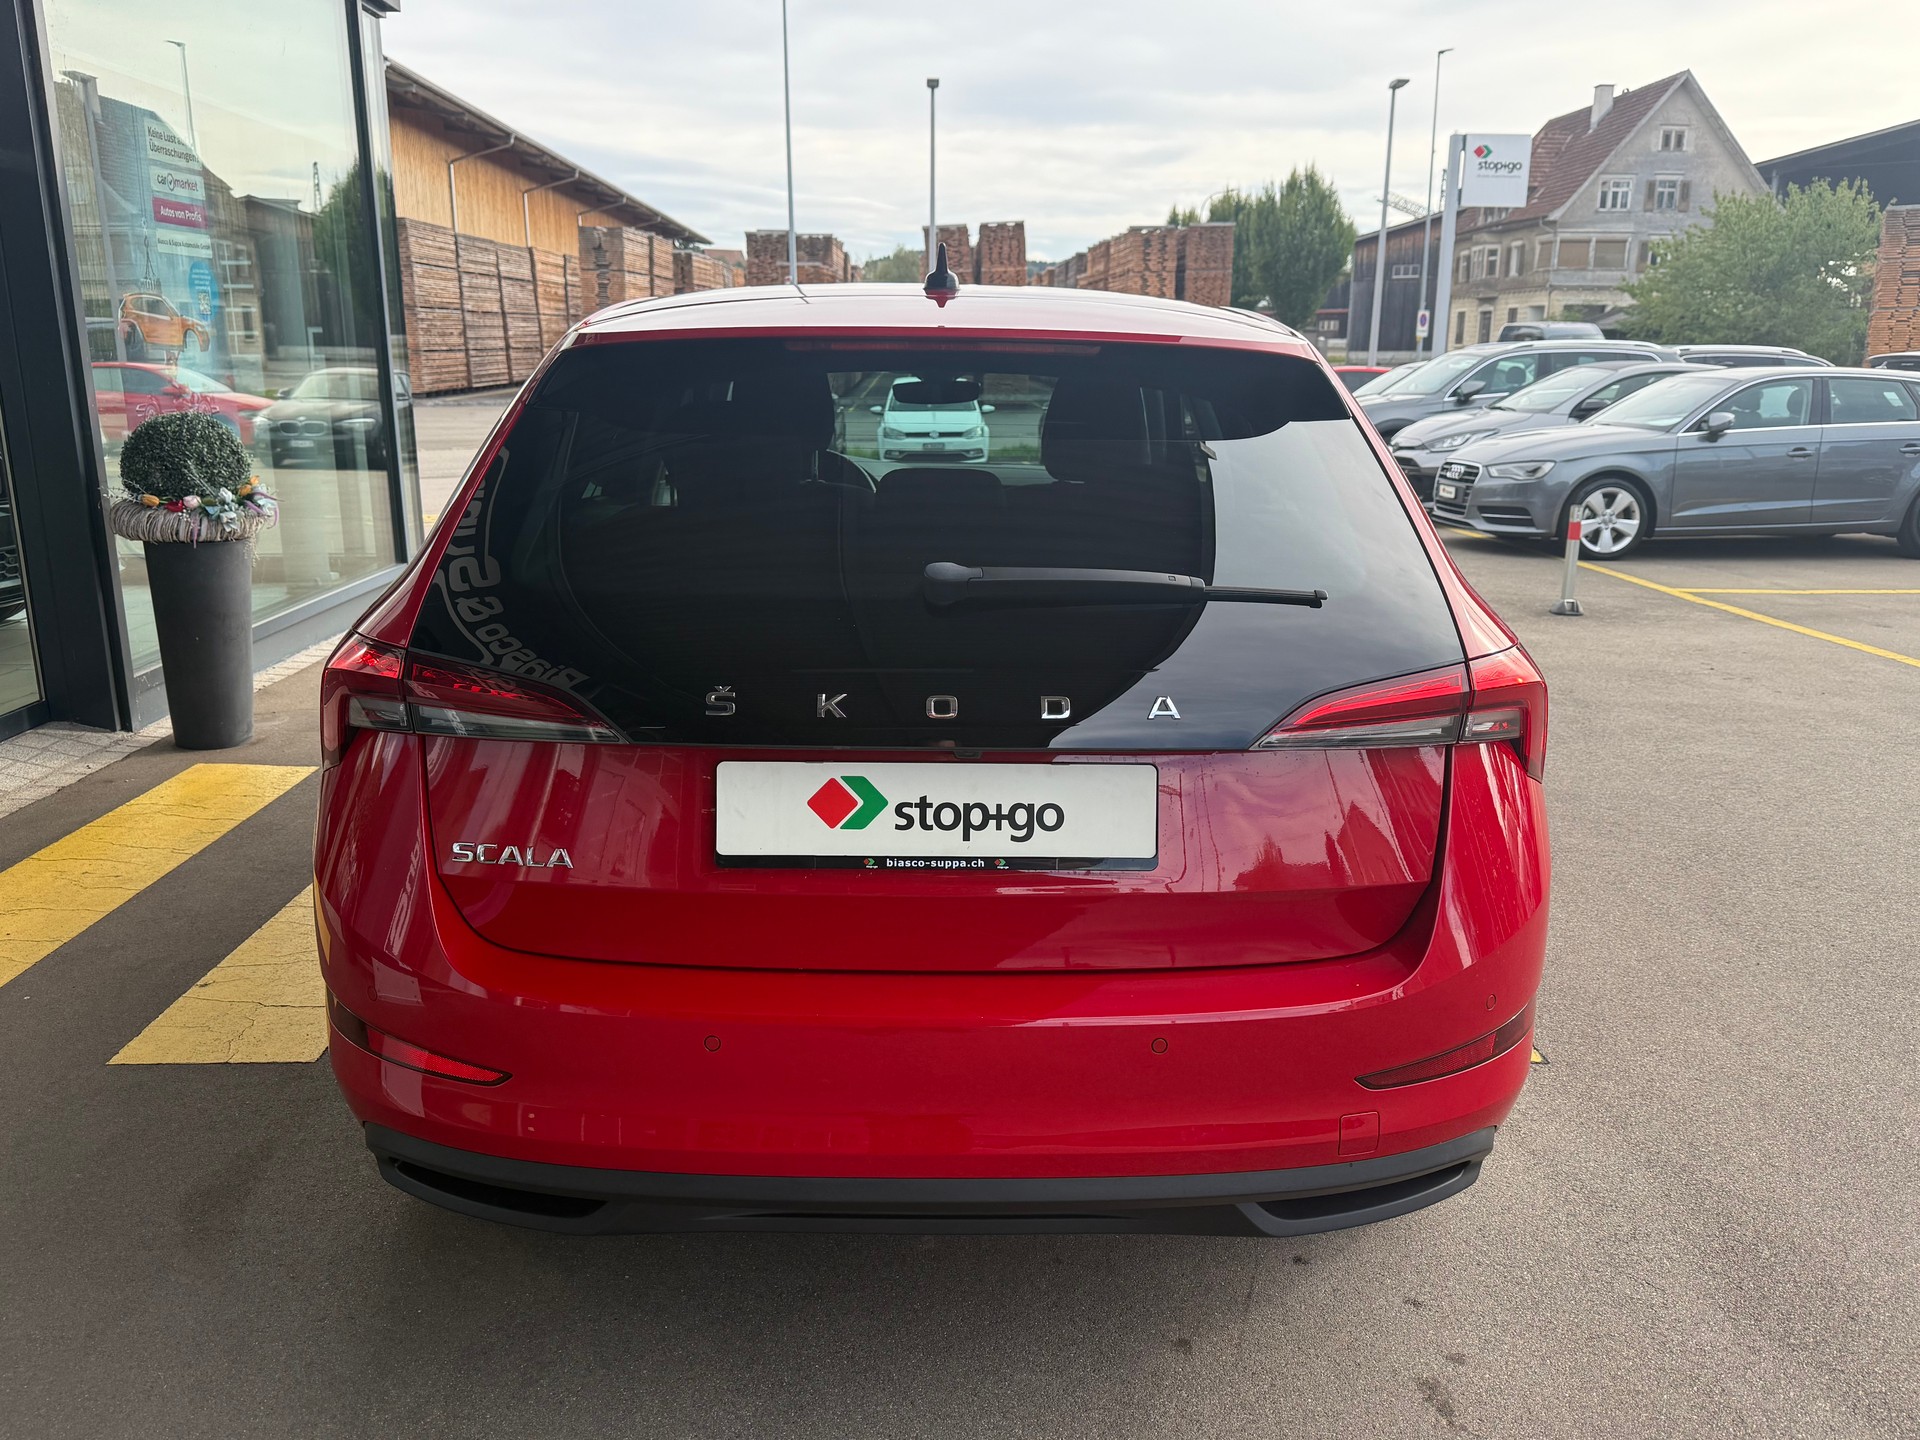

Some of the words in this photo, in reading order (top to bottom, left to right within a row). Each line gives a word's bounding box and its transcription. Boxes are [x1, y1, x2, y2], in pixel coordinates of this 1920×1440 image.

[147, 126, 163, 140] Keine
[163, 131, 177, 144] Lust
[1477, 160, 1523, 174] stop+go
[160, 205, 175, 218] Autos
[174, 209, 185, 219] von
[185, 209, 202, 222] Profis
[705, 685, 1182, 721] ŠKODA
[893, 795, 1066, 843] stop+go
[451, 842, 574, 869] SCALA
[886, 858, 985, 870] biasco-suppa.ch
